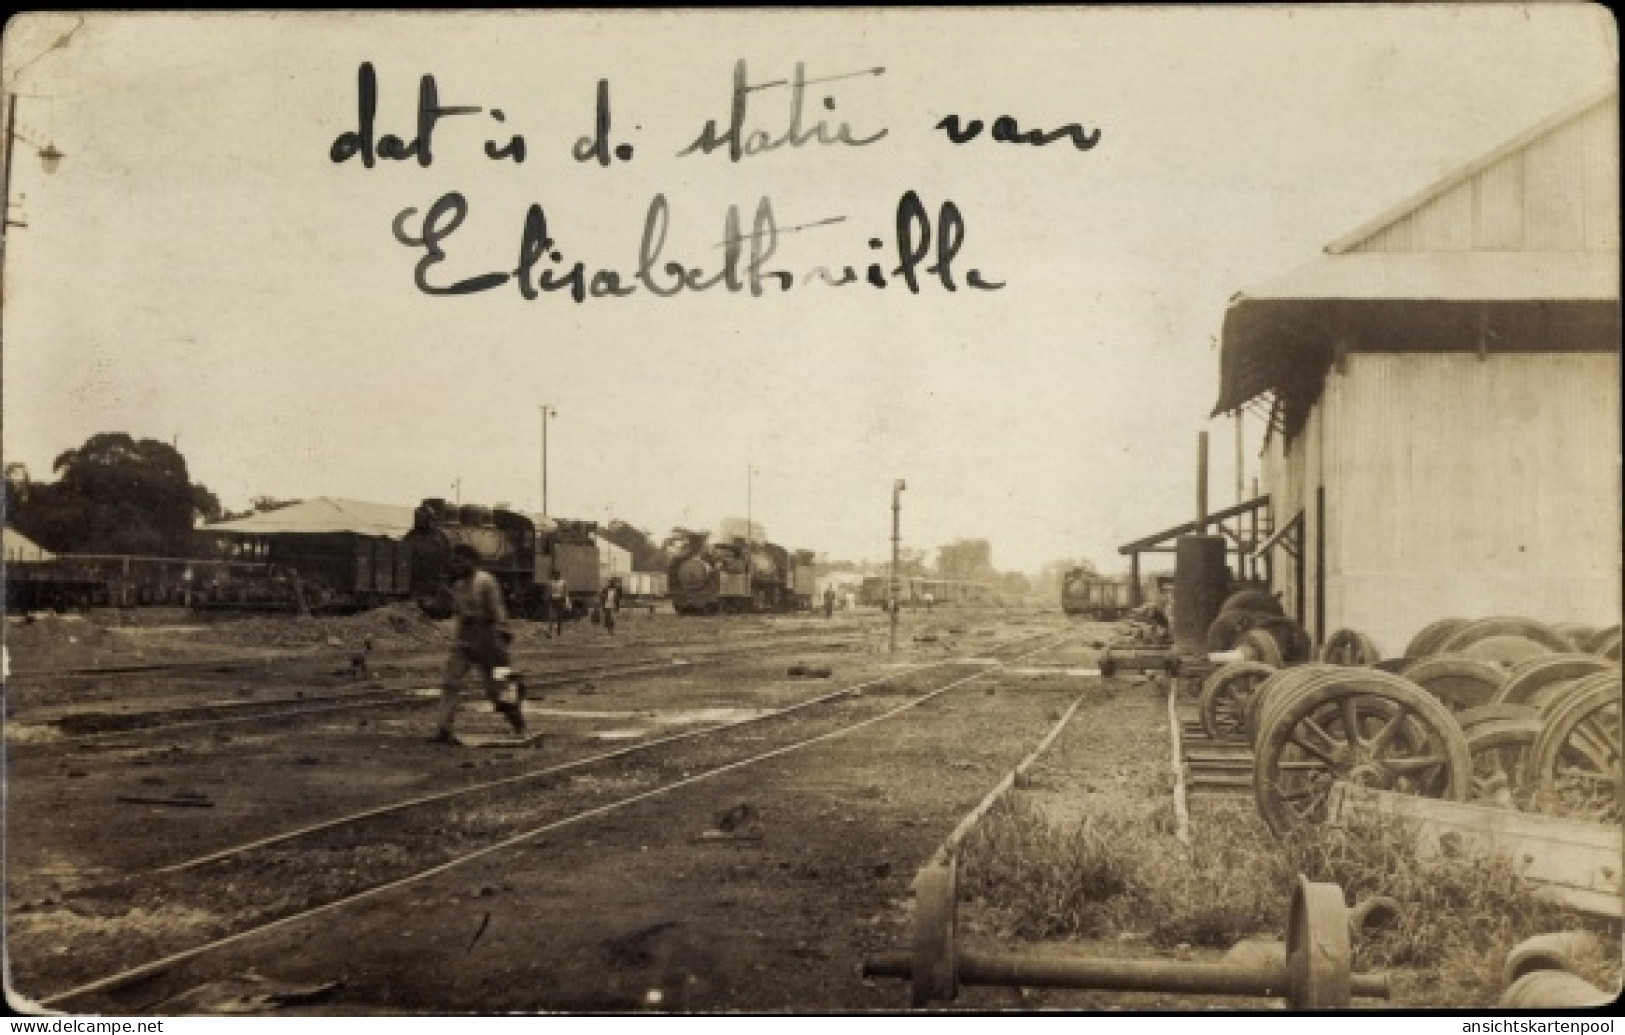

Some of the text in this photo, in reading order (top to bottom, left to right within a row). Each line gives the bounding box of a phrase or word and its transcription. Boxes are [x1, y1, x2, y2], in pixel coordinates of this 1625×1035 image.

[330, 61, 483, 168] dat
[484, 108, 527, 166] is
[676, 58, 888, 163] statie
[934, 113, 1102, 153] van
[392, 190, 1006, 303] Elisabethville
